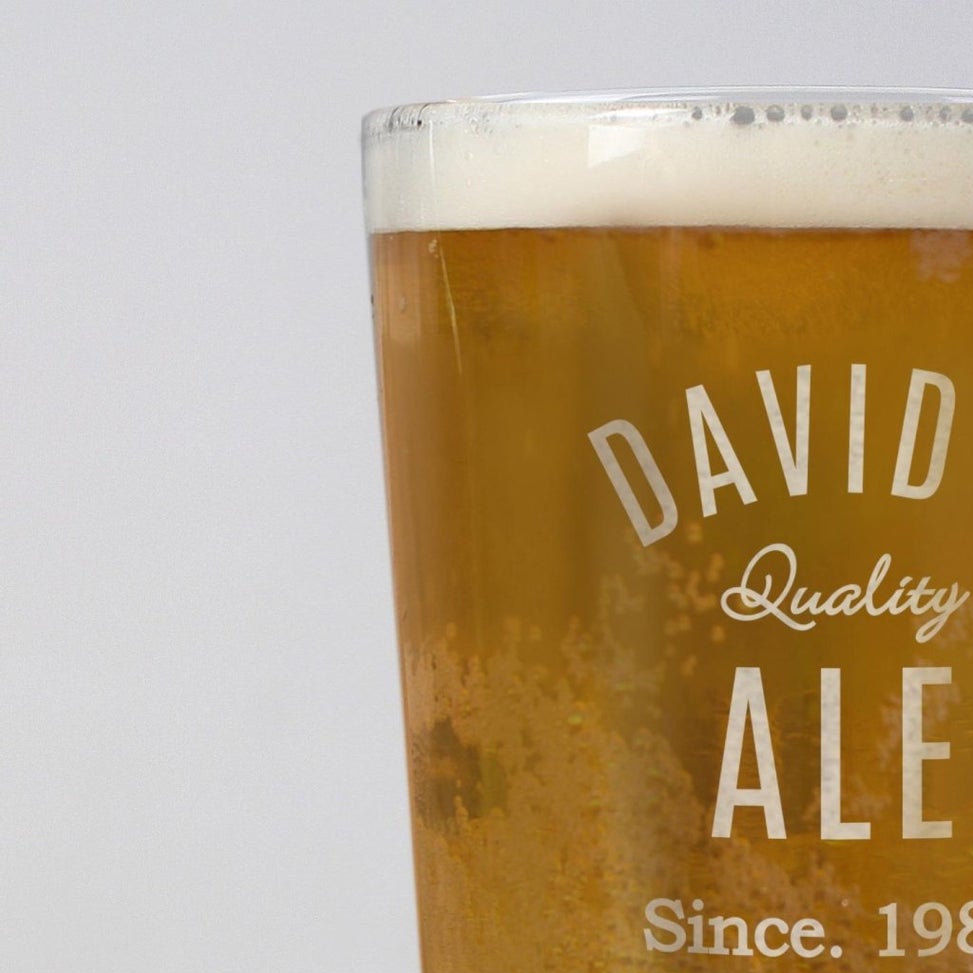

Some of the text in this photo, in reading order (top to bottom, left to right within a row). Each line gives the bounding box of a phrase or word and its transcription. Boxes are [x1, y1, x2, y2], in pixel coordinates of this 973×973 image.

[720, 543, 970, 643] Quality
[711, 666, 953, 840] ALE
[643, 898, 843, 958] Since.
